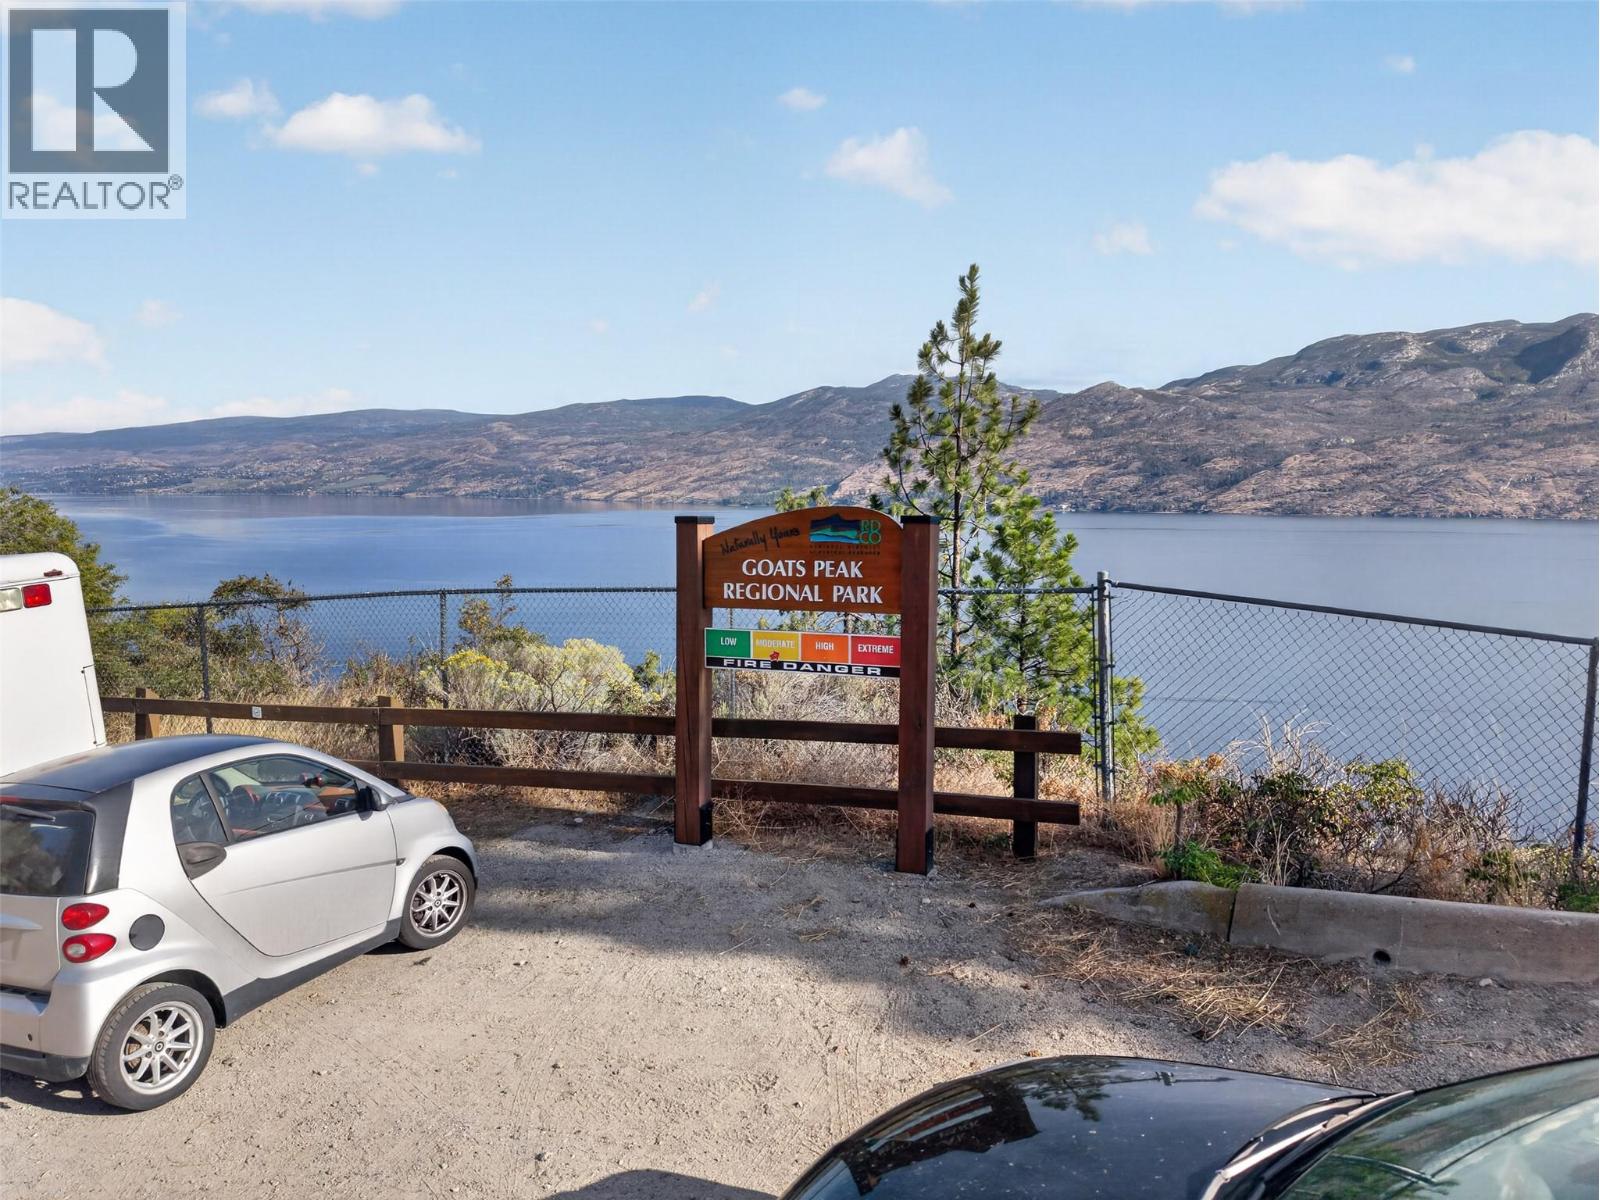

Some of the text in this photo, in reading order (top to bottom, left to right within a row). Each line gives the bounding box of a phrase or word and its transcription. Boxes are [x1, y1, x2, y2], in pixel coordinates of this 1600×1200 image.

[721, 532, 768, 555] Naturally
[741, 559, 863, 578] GOATS PEAK
[723, 582, 883, 604] REGIONAL PARK
[720, 637, 737, 646] LOW
[756, 639, 795, 649] MODERATE
[815, 641, 834, 651] HIGH
[857, 643, 894, 655] EXTREME
[723, 658, 882, 676] FIRE DANGER
